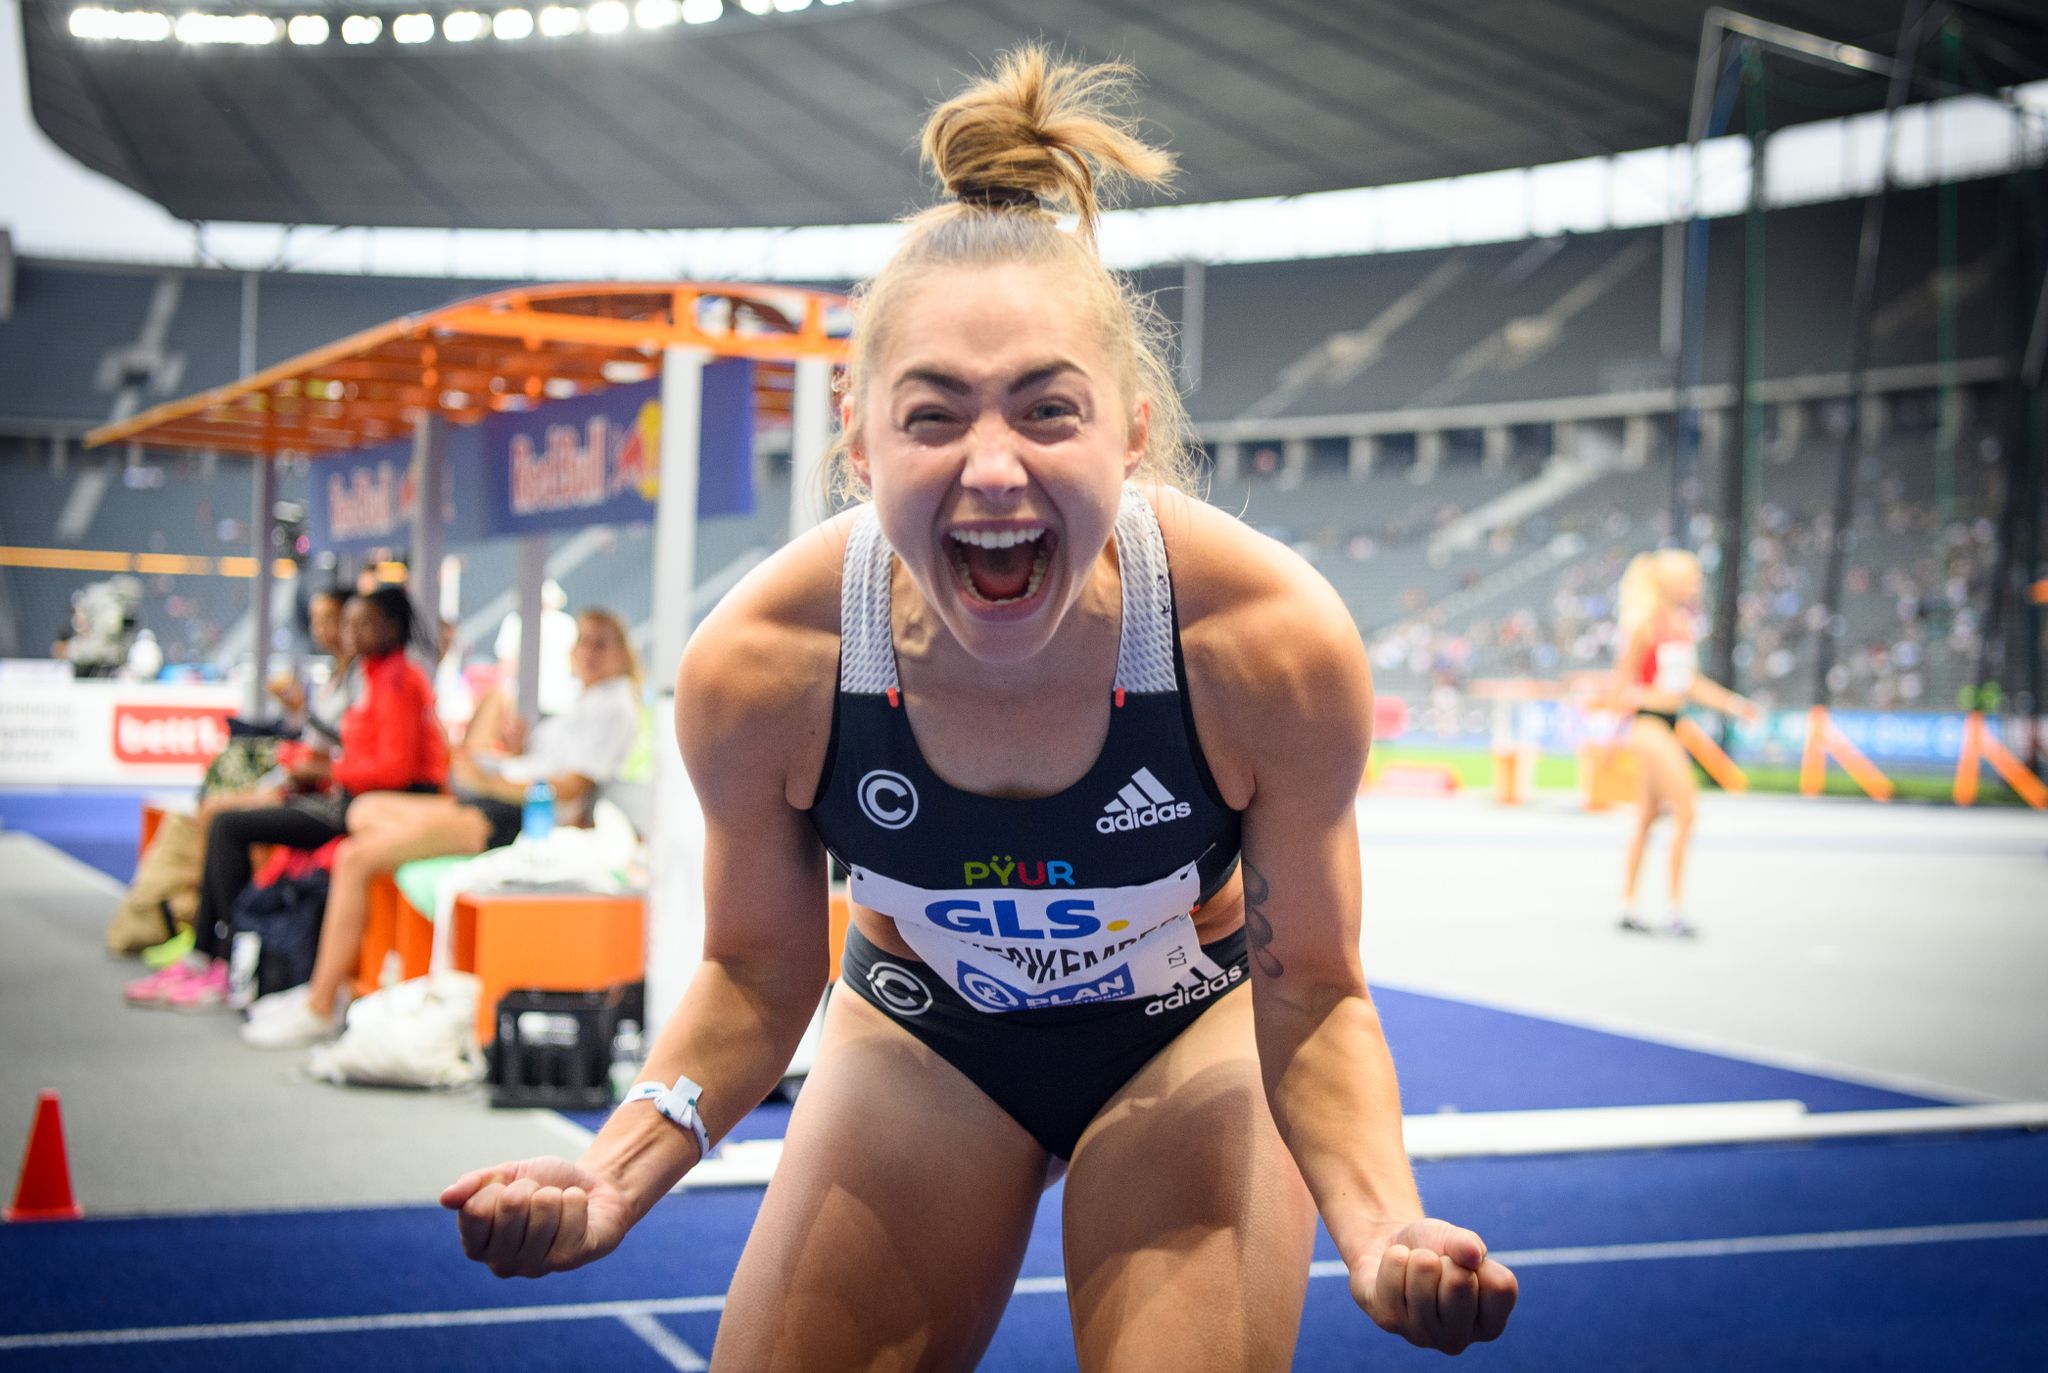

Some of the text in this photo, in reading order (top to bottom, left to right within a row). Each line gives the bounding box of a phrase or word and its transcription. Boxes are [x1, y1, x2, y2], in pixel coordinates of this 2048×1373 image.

[1096, 801, 1192, 834] adidas
[1166, 945, 1187, 970] 127
[1144, 965, 1243, 1016] adidas
